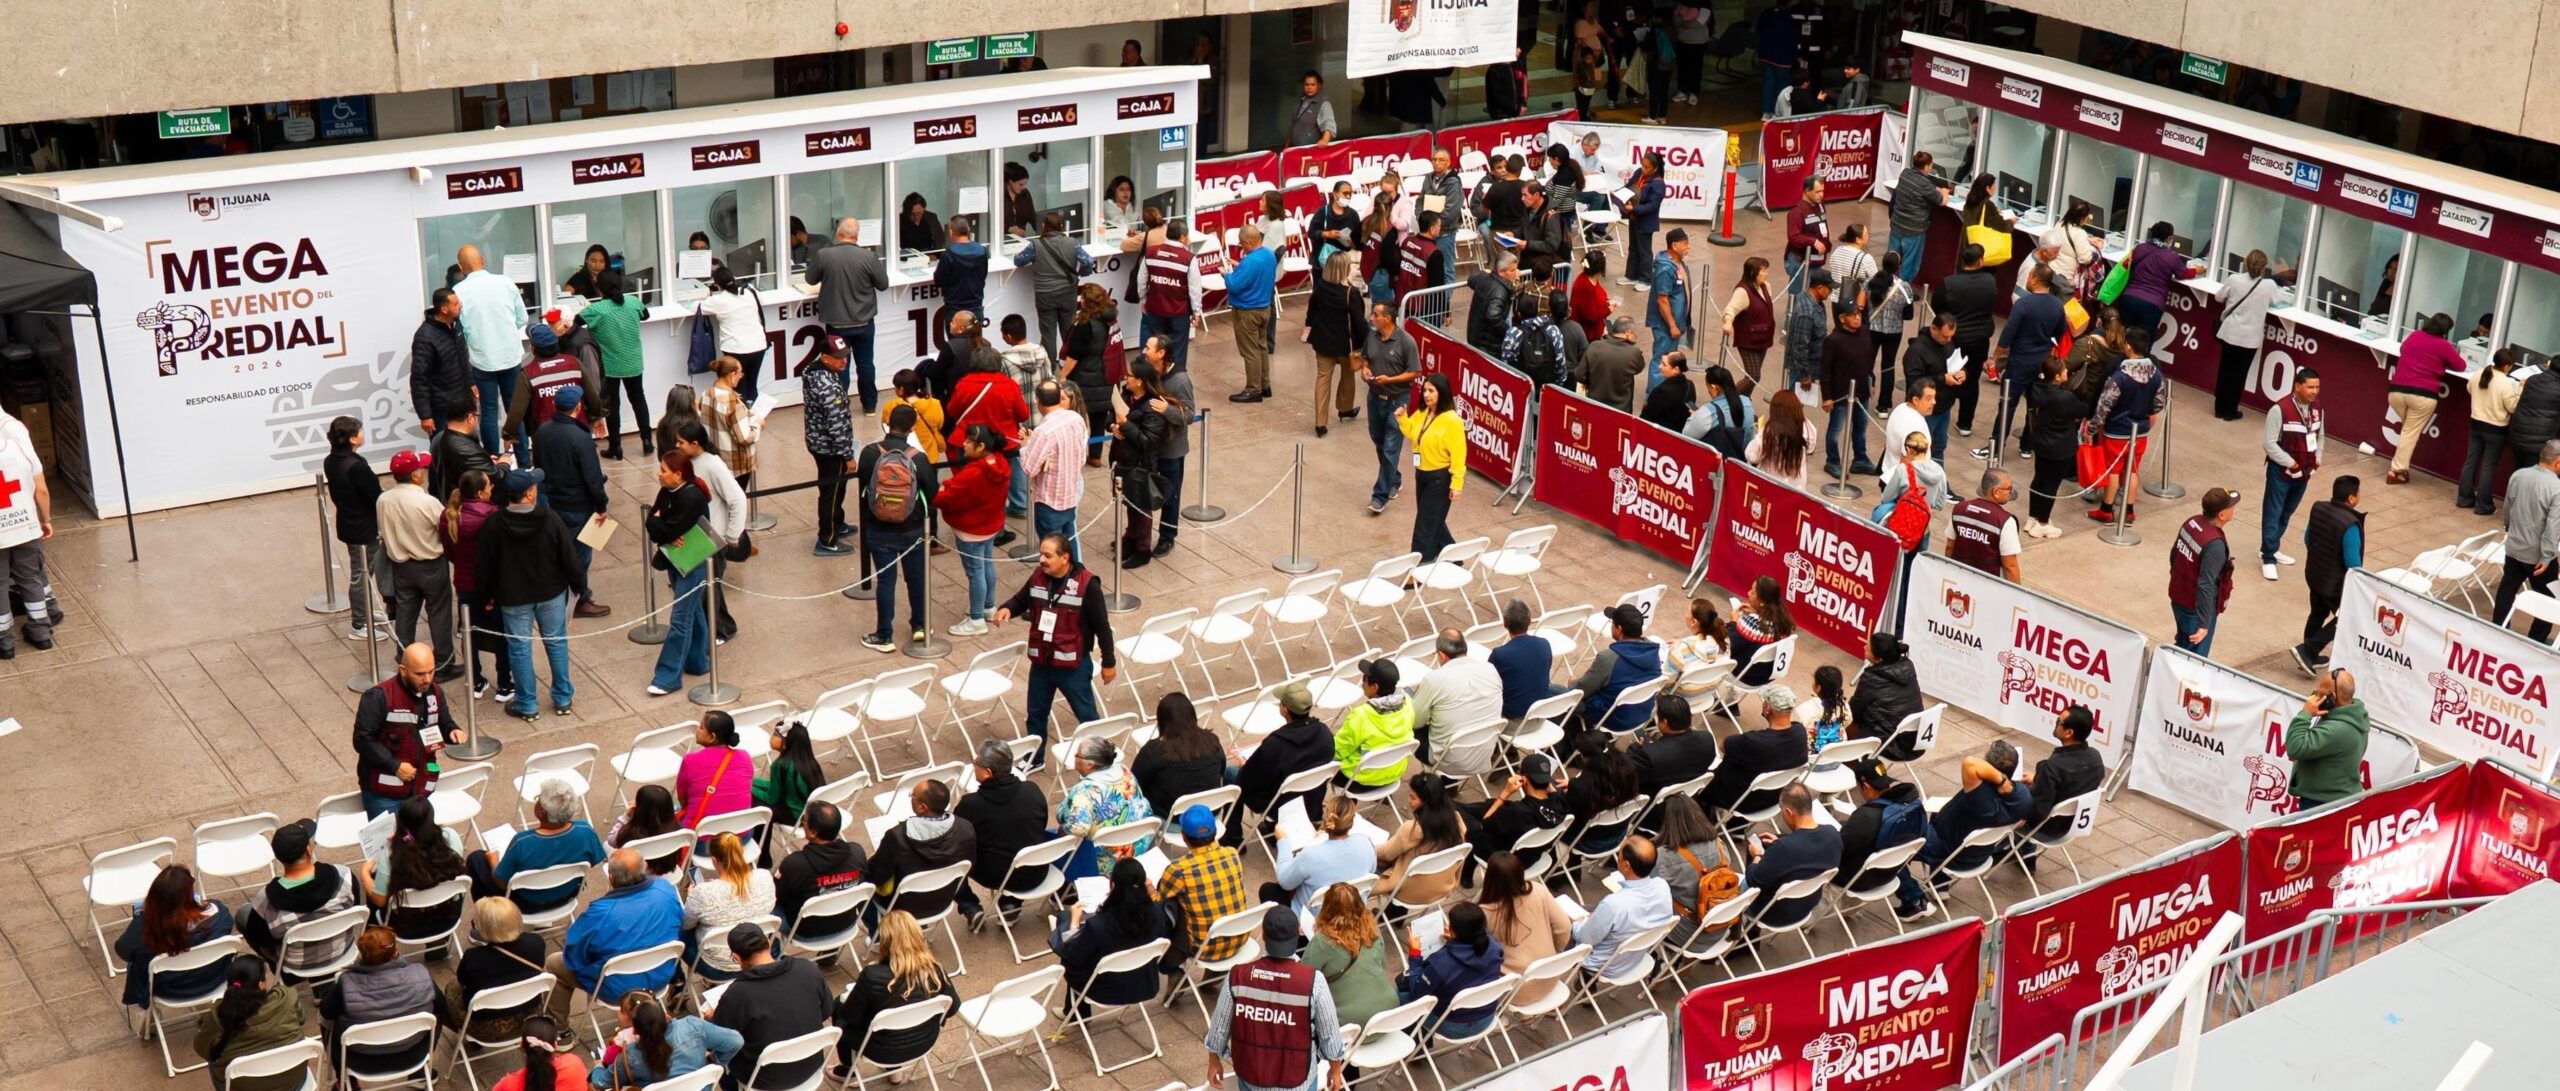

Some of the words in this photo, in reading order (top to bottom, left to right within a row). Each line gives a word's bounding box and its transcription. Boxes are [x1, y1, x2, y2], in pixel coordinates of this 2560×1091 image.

[998, 41, 1014, 49] RUTA
[1932, 64, 1960, 78] RECIBOS
[1960, 69, 1965, 82] 1
[1130, 100, 1162, 114] CAJA
[1164, 96, 1173, 110] 7
[2003, 84, 2031, 98] RECIBOS
[2031, 89, 2040, 102] 2
[178, 117, 199, 126] RUTA
[200, 117, 211, 125] DE
[928, 122, 962, 138] CAJA
[964, 119, 974, 136] 5
[1032, 110, 1064, 125] CAJA
[1065, 108, 1076, 123] 6
[2081, 106, 2111, 122] RECIBOS
[2111, 112, 2120, 126] 3
[821, 134, 855, 150] CAJA
[854, 133, 864, 147] 4
[1820, 128, 1872, 151] MEGA
[2164, 130, 2195, 146] RECIBOS
[2195, 137, 2204, 150] 4
[589, 162, 628, 178] CAJA
[630, 158, 642, 175] 2
[708, 149, 743, 164] CAJA
[742, 146, 752, 160] 3
[1772, 156, 1804, 168] TIJUANA
[1814, 154, 1869, 182] PREDIAL
[1834, 152, 1864, 164] EVENTO
[2251, 154, 2284, 171] RECIBOS
[2284, 162, 2294, 176] 5
[465, 177, 505, 192] CAJA
[509, 172, 518, 189] 1
[2342, 182, 2378, 198] RECIBOS
[2378, 189, 2389, 204] 6
[222, 193, 270, 206] TIJUANA
[2440, 210, 2477, 226] CATASTRO
[2478, 216, 2490, 232] 7
[161, 237, 328, 294] MEGA
[1150, 274, 1181, 287] PREDIAL
[210, 288, 314, 320] EVENTO
[317, 290, 334, 300] DEL
[137, 301, 334, 377] PREDIAL
[234, 359, 282, 374] 2026
[186, 388, 267, 407] RESPONSABILIDAD
[268, 386, 280, 396] DE
[282, 382, 312, 394] TODOS
[1462, 367, 1514, 422] MEGA
[1474, 405, 1508, 435] EVENTO
[1554, 440, 1598, 470] TIJUANA
[1622, 438, 1694, 496] MEGA
[1608, 466, 1690, 540] PREDIAL
[1639, 478, 1684, 510] EVENTO
[1, 516, 30, 528] XICANA
[1732, 520, 1775, 552] TIJUANA
[1799, 521, 1874, 584] MEGA
[1784, 550, 1866, 632] PREDIAL
[1816, 565, 1864, 600] EVENTO
[1640, 601, 1650, 619] 2
[1928, 619, 1983, 650] TIJUANA
[1776, 651, 1786, 671] 3
[2014, 618, 2112, 684] MEGA
[2358, 634, 2412, 670] TIJUANA
[2037, 664, 2099, 700] EVENTO
[2447, 640, 2548, 709] MEGA
[1998, 650, 2104, 734] PREDL
[2470, 686, 2534, 725] EVENTO
[2428, 670, 2538, 760] PREDIAL
[1920, 723, 1934, 742] 4
[2164, 718, 2225, 756] TIJUANA
[2077, 807, 2090, 830] 5
[2351, 802, 2439, 862] MEGA
[2480, 831, 2548, 878] TIJUANA
[2259, 876, 2314, 907] TIJUANA
[2122, 874, 2222, 944] MEGA
[2144, 918, 2208, 959] EVENTO
[2210, 918, 2222, 929] DEL
[2018, 960, 2080, 996] TIJUANA
[1828, 962, 1949, 1028] MEGA
[1236, 1003, 1296, 1026] PREDIAL
[1858, 1007, 1935, 1045] EVENTO
[1936, 1005, 1949, 1016] DEL
[1704, 1045, 1782, 1080] TIJUANA
[1802, 1030, 1944, 1091] PREDIAL
[1865, 1074, 1901, 1091] 2026
